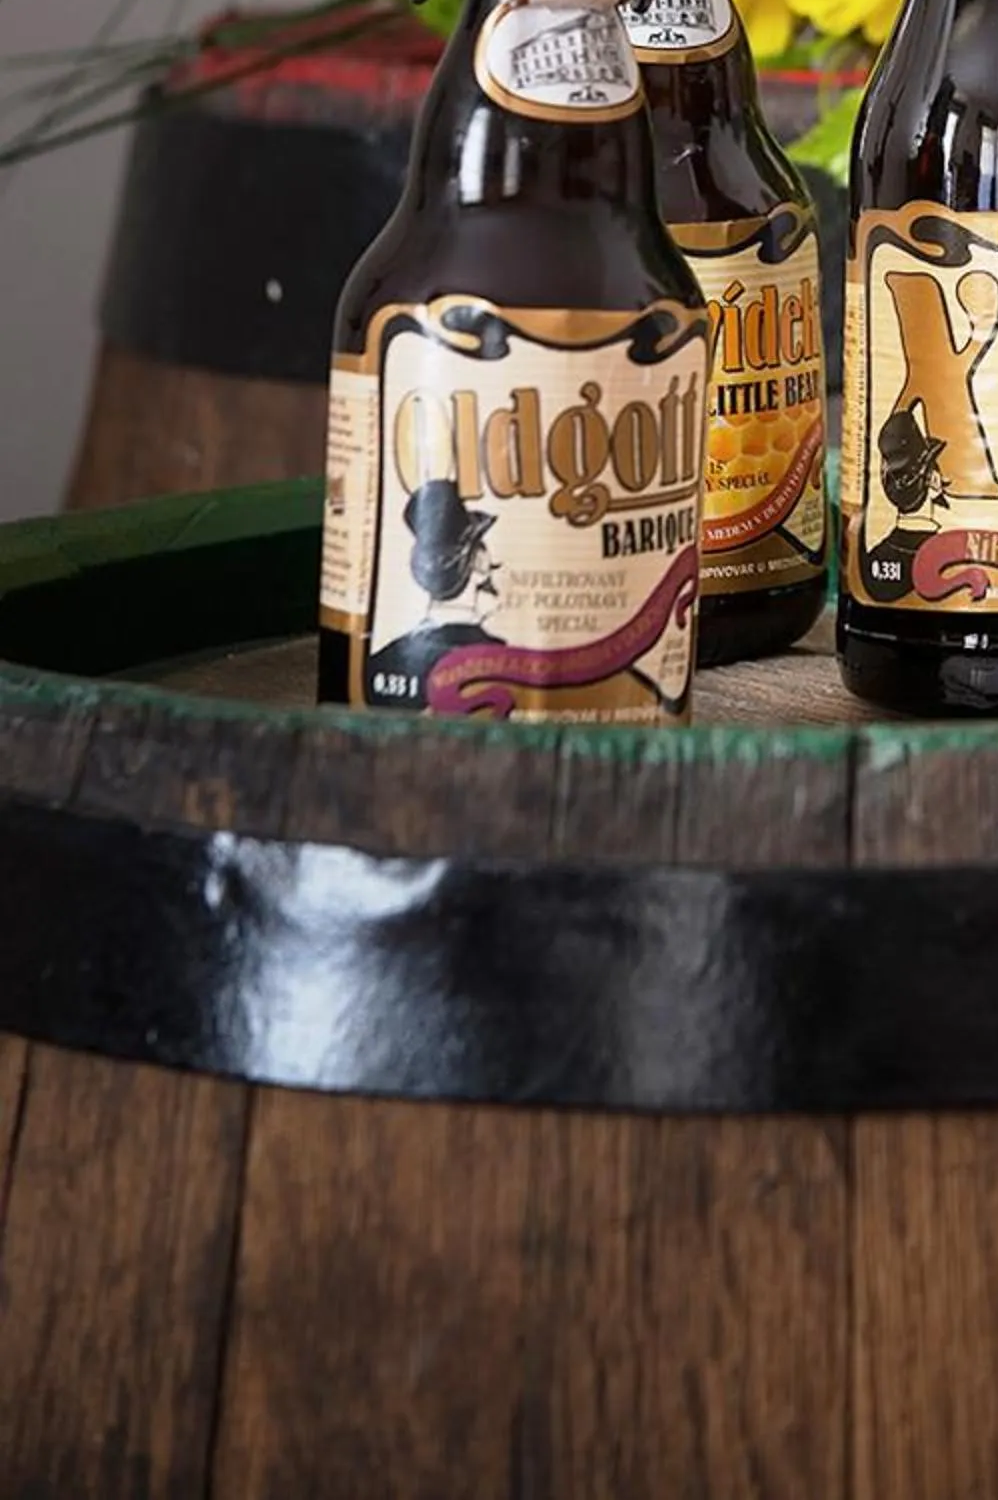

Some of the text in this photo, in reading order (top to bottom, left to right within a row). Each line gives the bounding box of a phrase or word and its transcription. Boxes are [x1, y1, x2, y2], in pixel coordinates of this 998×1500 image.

[708, 379, 779, 417] ITTLE
[394, 371, 699, 529] Oldgott
[602, 506, 696, 560] BARIQUE
